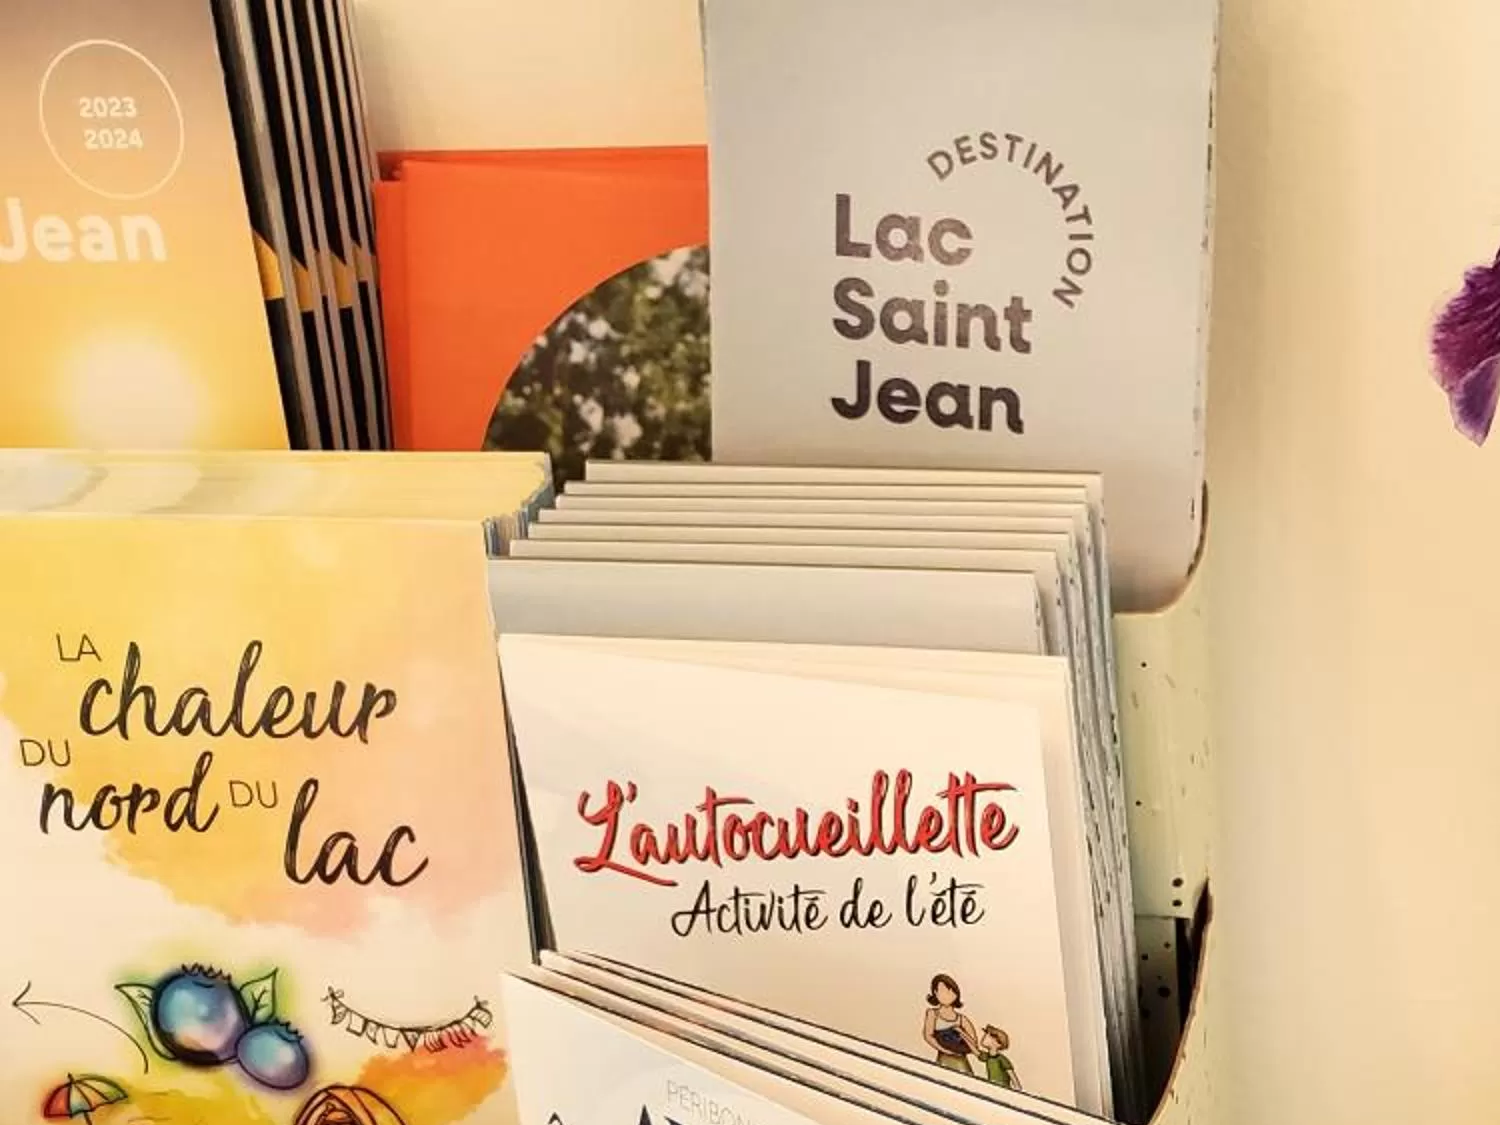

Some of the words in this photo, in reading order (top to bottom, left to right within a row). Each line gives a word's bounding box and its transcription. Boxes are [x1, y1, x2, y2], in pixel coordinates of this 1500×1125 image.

[79, 96, 137, 118] 2023
[84, 128, 143, 150] 2024
[0, 197, 167, 263] Jean
[834, 193, 974, 267] Lac
[927, 131, 1094, 309] DESTINATION
[832, 276, 1033, 354] Saint
[831, 360, 1025, 434] Jean
[56, 634, 102, 663] LA
[79, 640, 398, 744] chaleur
[20, 739, 72, 768] DU
[39, 751, 220, 835] nord
[229, 780, 278, 808] DU
[573, 768, 1020, 888] L'autocueillette
[284, 778, 429, 887] lac
[670, 879, 829, 937] Activité
[838, 877, 893, 930] de
[905, 872, 988, 930] l'été
